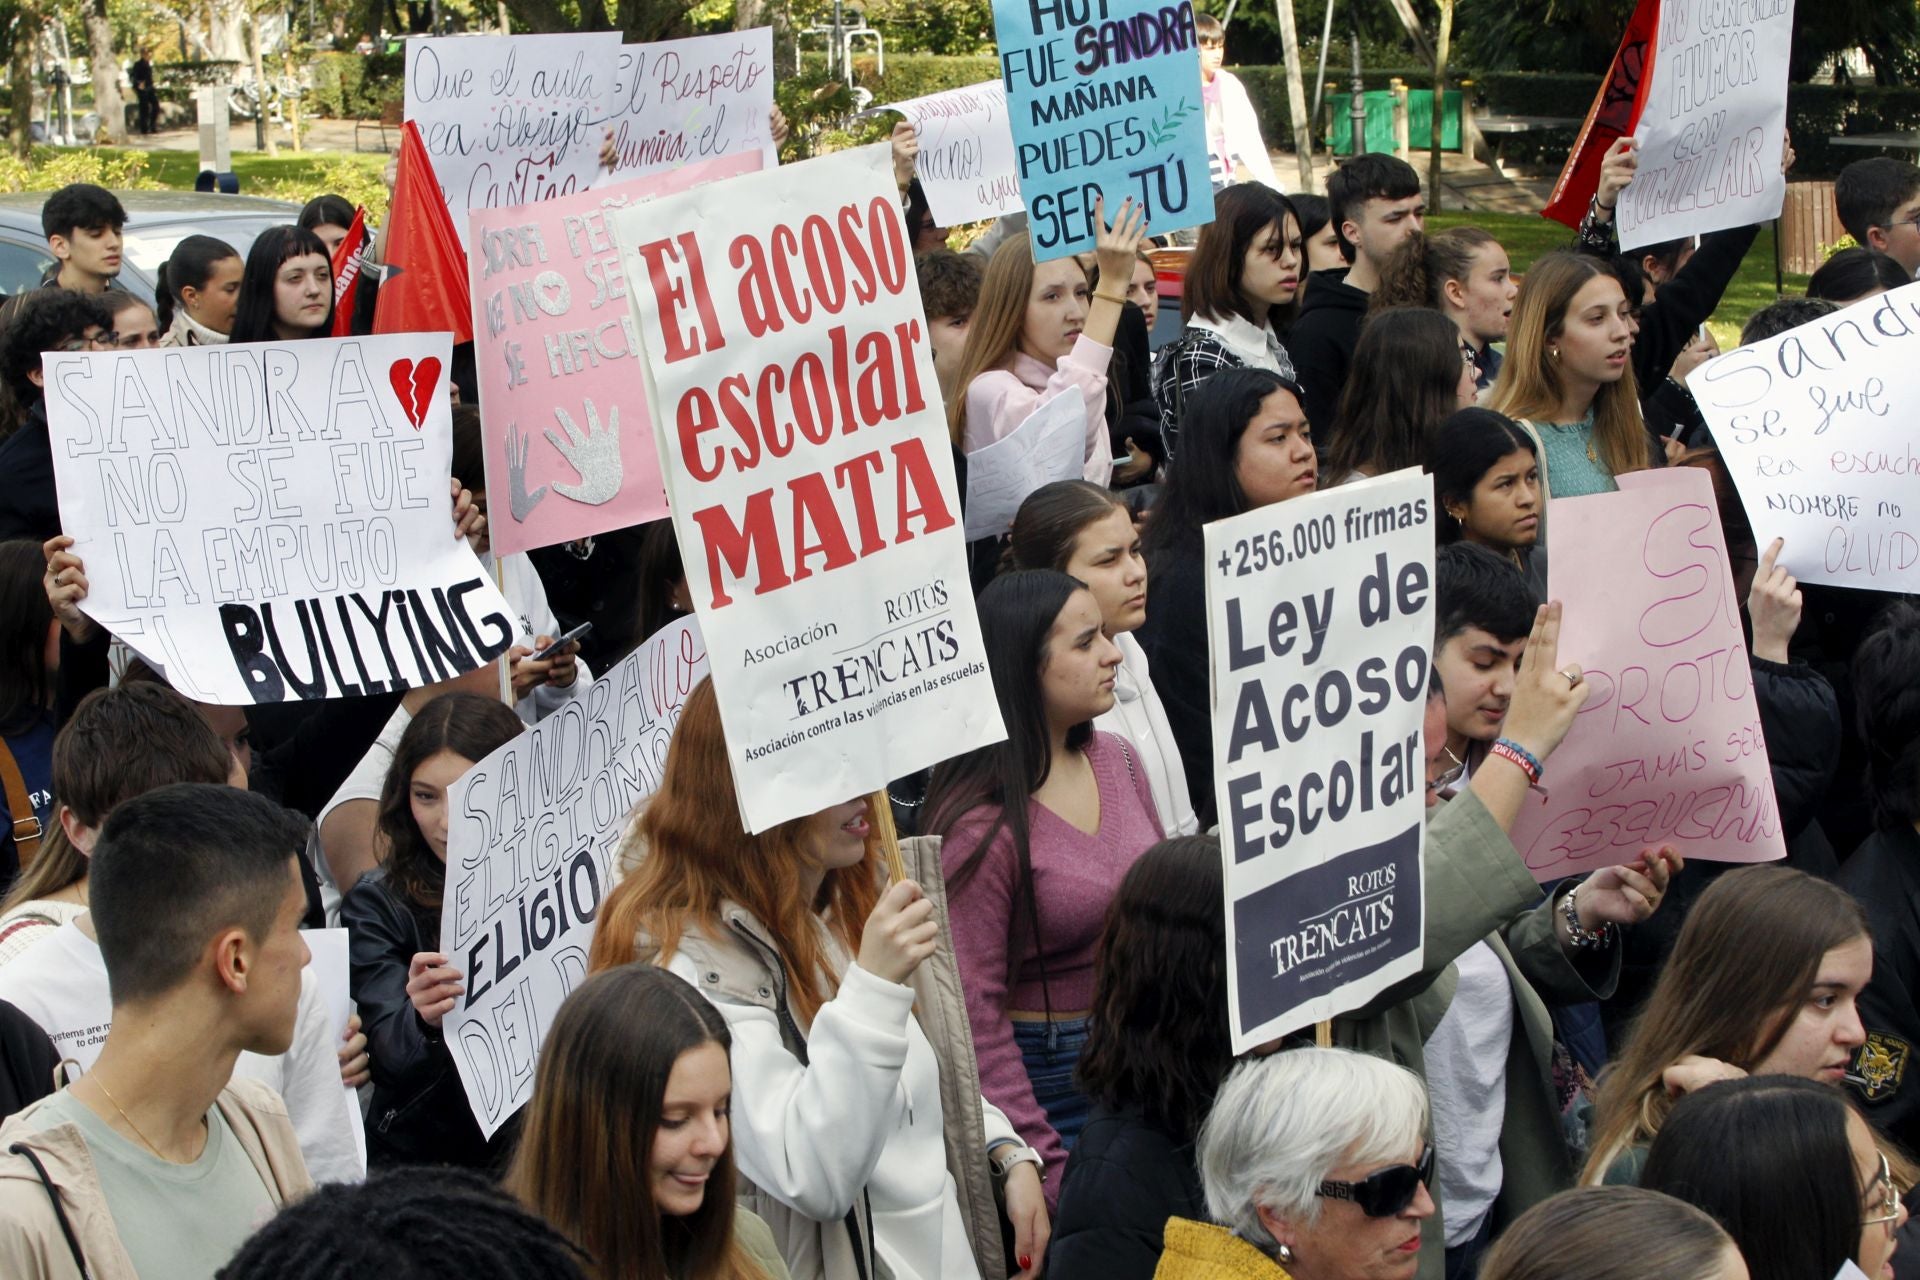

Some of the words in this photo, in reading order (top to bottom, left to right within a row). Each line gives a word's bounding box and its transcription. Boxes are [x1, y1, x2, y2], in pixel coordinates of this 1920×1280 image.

[413, 45, 474, 103] Que
[490, 45, 520, 97] el
[532, 50, 601, 100] aula
[653, 43, 765, 106] Respeto
[1002, 39, 1068, 93] FUE
[1074, 1, 1197, 76] SANDRA
[1670, 29, 1758, 119] HUMOR
[698, 104, 730, 156] el
[1031, 75, 1157, 127] MAÑANA
[1673, 110, 1727, 161] CON
[1019, 117, 1146, 179] PUEDES
[1620, 126, 1763, 233] HUMILLAR
[1031, 183, 1111, 249] SER
[1129, 153, 1188, 221] TÚ
[509, 270, 571, 325] NO
[584, 256, 627, 310] SE
[638, 231, 726, 364] El
[729, 196, 907, 338] acoso
[56, 341, 393, 458] SANDRA
[675, 319, 926, 483] escolar
[1731, 410, 1786, 444] se
[99, 453, 187, 527] NO
[227, 446, 302, 522] SE
[330, 439, 429, 514] FUE
[692, 437, 956, 610] MATA
[1766, 492, 1860, 521] NOMBRE
[114, 529, 200, 609] LA
[202, 516, 397, 604] EMPUJO
[1217, 514, 1335, 577] +256.000
[1344, 498, 1428, 544] firmas
[1825, 525, 1919, 577] OLVID
[218, 577, 514, 705] BULLYiNG
[743, 621, 838, 668] Asociación
[884, 579, 949, 624] ROTOS
[1225, 587, 1335, 672] Ley
[1358, 552, 1429, 628] de
[745, 730, 806, 762] Asociación
[807, 715, 842, 739] contra
[844, 709, 864, 725] las
[909, 685, 922, 698] en
[923, 678, 939, 693] las
[940, 660, 985, 686] escuelas
[783, 619, 959, 721] TRENCATS
[1227, 645, 1427, 764] Acoso
[462, 653, 654, 870] SANDRA
[1227, 730, 1418, 865] Escolar
[1348, 862, 1396, 897] ROTOS
[1270, 894, 1394, 979] TRENCATS
[76, 1038, 85, 1048] to
[87, 1025, 102, 1036] are
